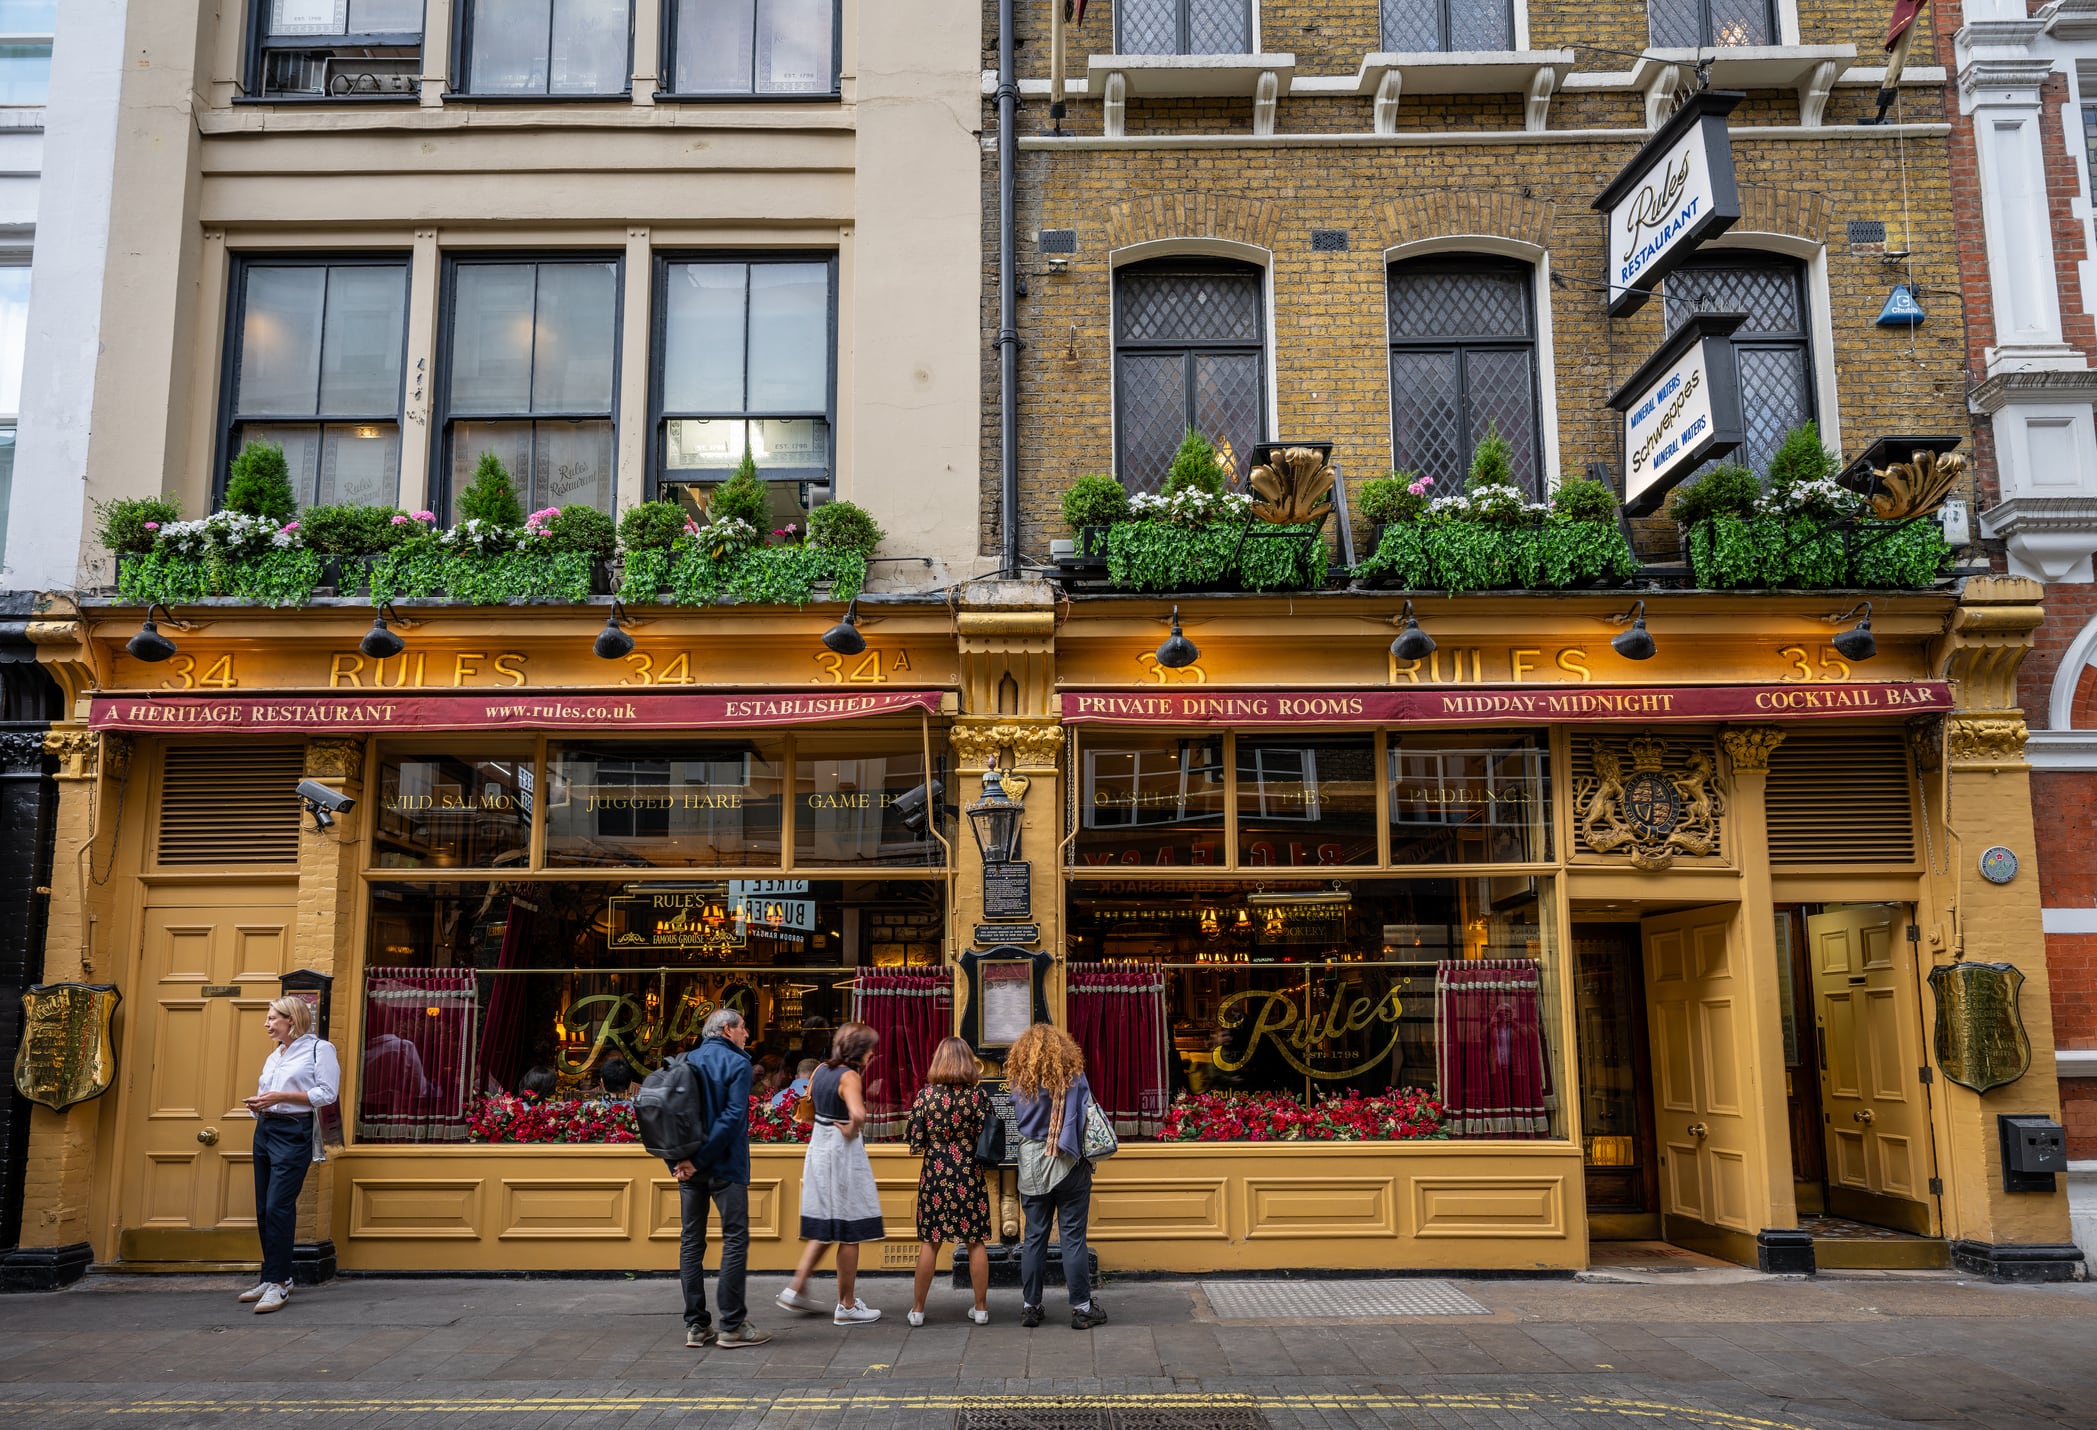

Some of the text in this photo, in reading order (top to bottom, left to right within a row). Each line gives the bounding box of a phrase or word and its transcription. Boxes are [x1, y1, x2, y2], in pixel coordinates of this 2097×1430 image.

[1623, 150, 1690, 262] Rules
[1621, 196, 1699, 284] RESTAURANT
[1891, 306, 1919, 314] Chubb
[1630, 372, 1681, 430] MINERAL WATERS
[1632, 369, 1701, 474] Schweppes
[1653, 414, 1707, 471] MINERAL WATERS
[549, 472, 598, 497] Restaurant
[160, 653, 239, 689] 34
[329, 652, 529, 689] RULES
[619, 651, 696, 687] 34
[1777, 645, 1852, 681] 35
[724, 697, 876, 718] ESTABLISHED
[1078, 696, 1364, 715] PRIVATE DINING ROOMS
[1441, 694, 1675, 713] MIDDAY-MIDNIGHT
[1755, 687, 1937, 709] COCKTAIL BAR
[104, 705, 397, 722] A HERITAGE RESTAURANT
[485, 703, 637, 719] www.rules.co.uk
[383, 795, 433, 810] WILD
[586, 793, 743, 813] JUGGED HARE
[808, 793, 871, 809] GAME
[1409, 788, 1533, 803] PUDDINGS
[653, 893, 706, 909] RULE'S
[652, 933, 705, 945] FAMOUS GROUSE
[1277, 926, 1326, 937] OOKERY
[1211, 981, 1404, 1080] Rules
